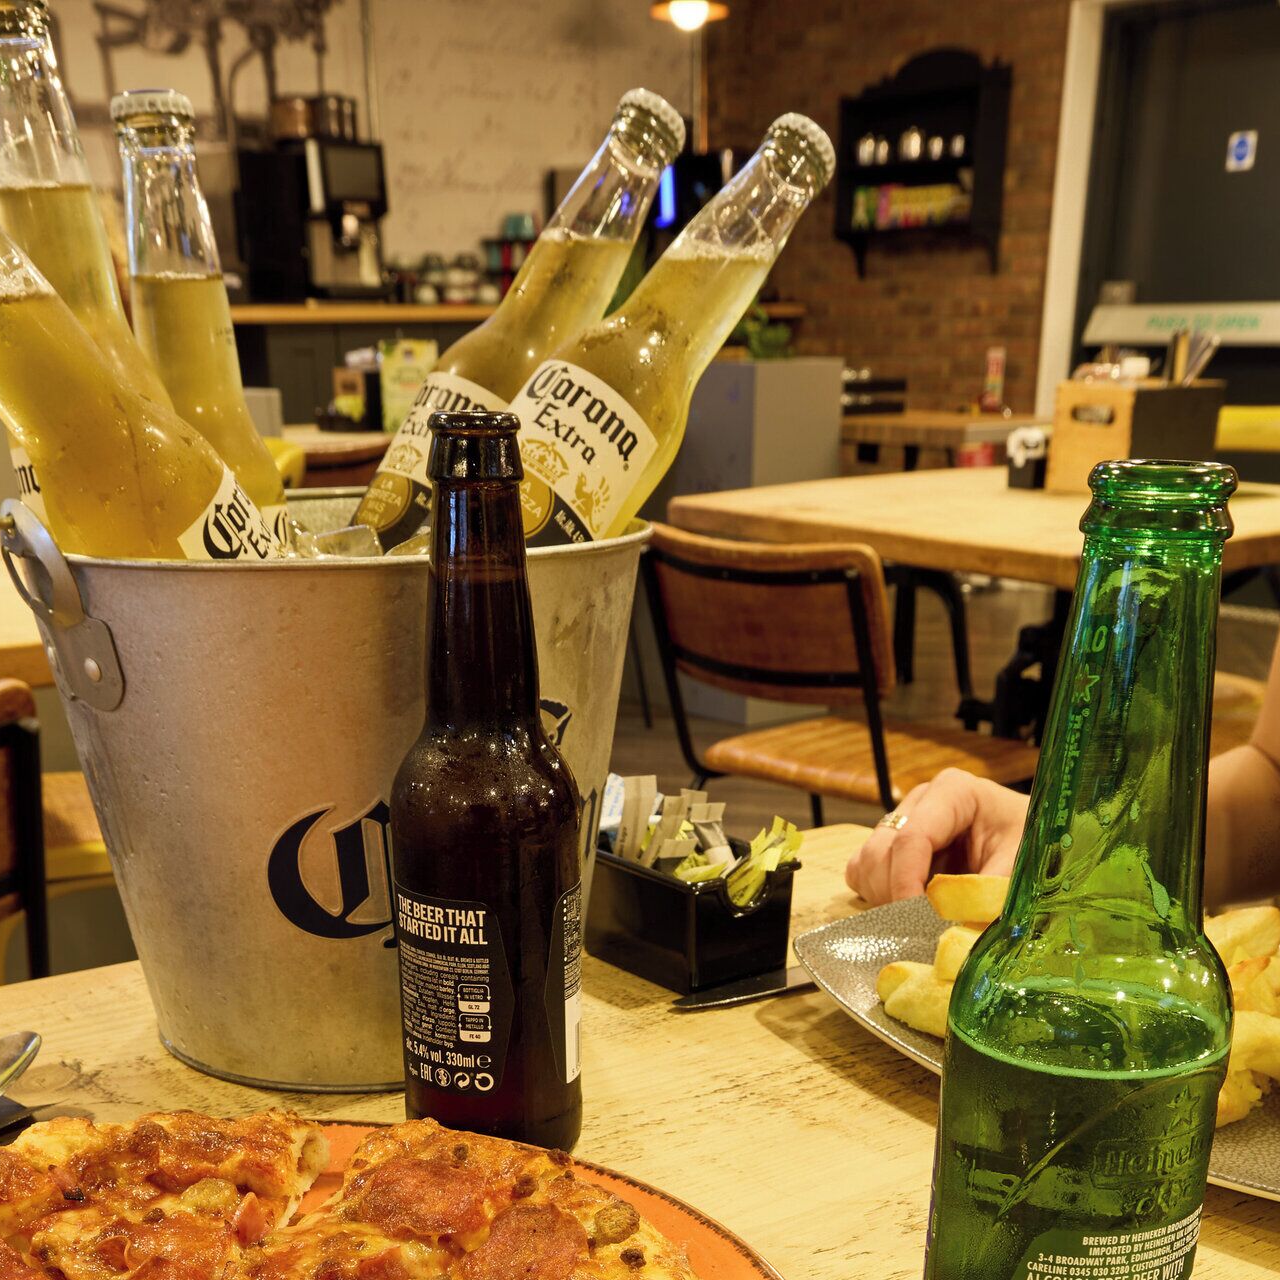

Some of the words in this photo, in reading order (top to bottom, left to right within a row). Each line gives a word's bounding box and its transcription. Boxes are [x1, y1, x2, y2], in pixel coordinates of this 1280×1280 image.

[414, 378, 487, 413] oron
[526, 365, 638, 462] Corona
[533, 402, 596, 465] Extra
[398, 893, 412, 916] THE
[413, 901, 444, 924] BEER
[445, 909, 486, 927] THAT
[399, 912, 441, 940] STARTED
[443, 926, 457, 943] IT
[460, 928, 488, 945] ALL
[414, 1040, 429, 1060] 5.4%
[430, 1050, 444, 1064] vol.
[446, 1051, 475, 1068] 330ml
[1082, 1236, 1118, 1246] BREWED
[1119, 1234, 1131, 1244] BY
[1131, 1226, 1167, 1243] HEINEKEN
[1089, 1245, 1132, 1256] IMPORTED
[1133, 1243, 1144, 1253] BY
[1144, 1233, 1176, 1250] HEINEKEN
[1027, 1261, 1068, 1276] CARELINE
[1069, 1267, 1091, 1276] 0345
[1092, 1267, 1109, 1277] 030
[1110, 1265, 1130, 1275] 3280
[1038, 1252, 1054, 1264] 3-4
[1055, 1255, 1105, 1267] BROADWAY
[1105, 1255, 1129, 1266] PARK,
[1130, 1245, 1173, 1263] EDINBURGH,
[1162, 1256, 1185, 1280] WITH
